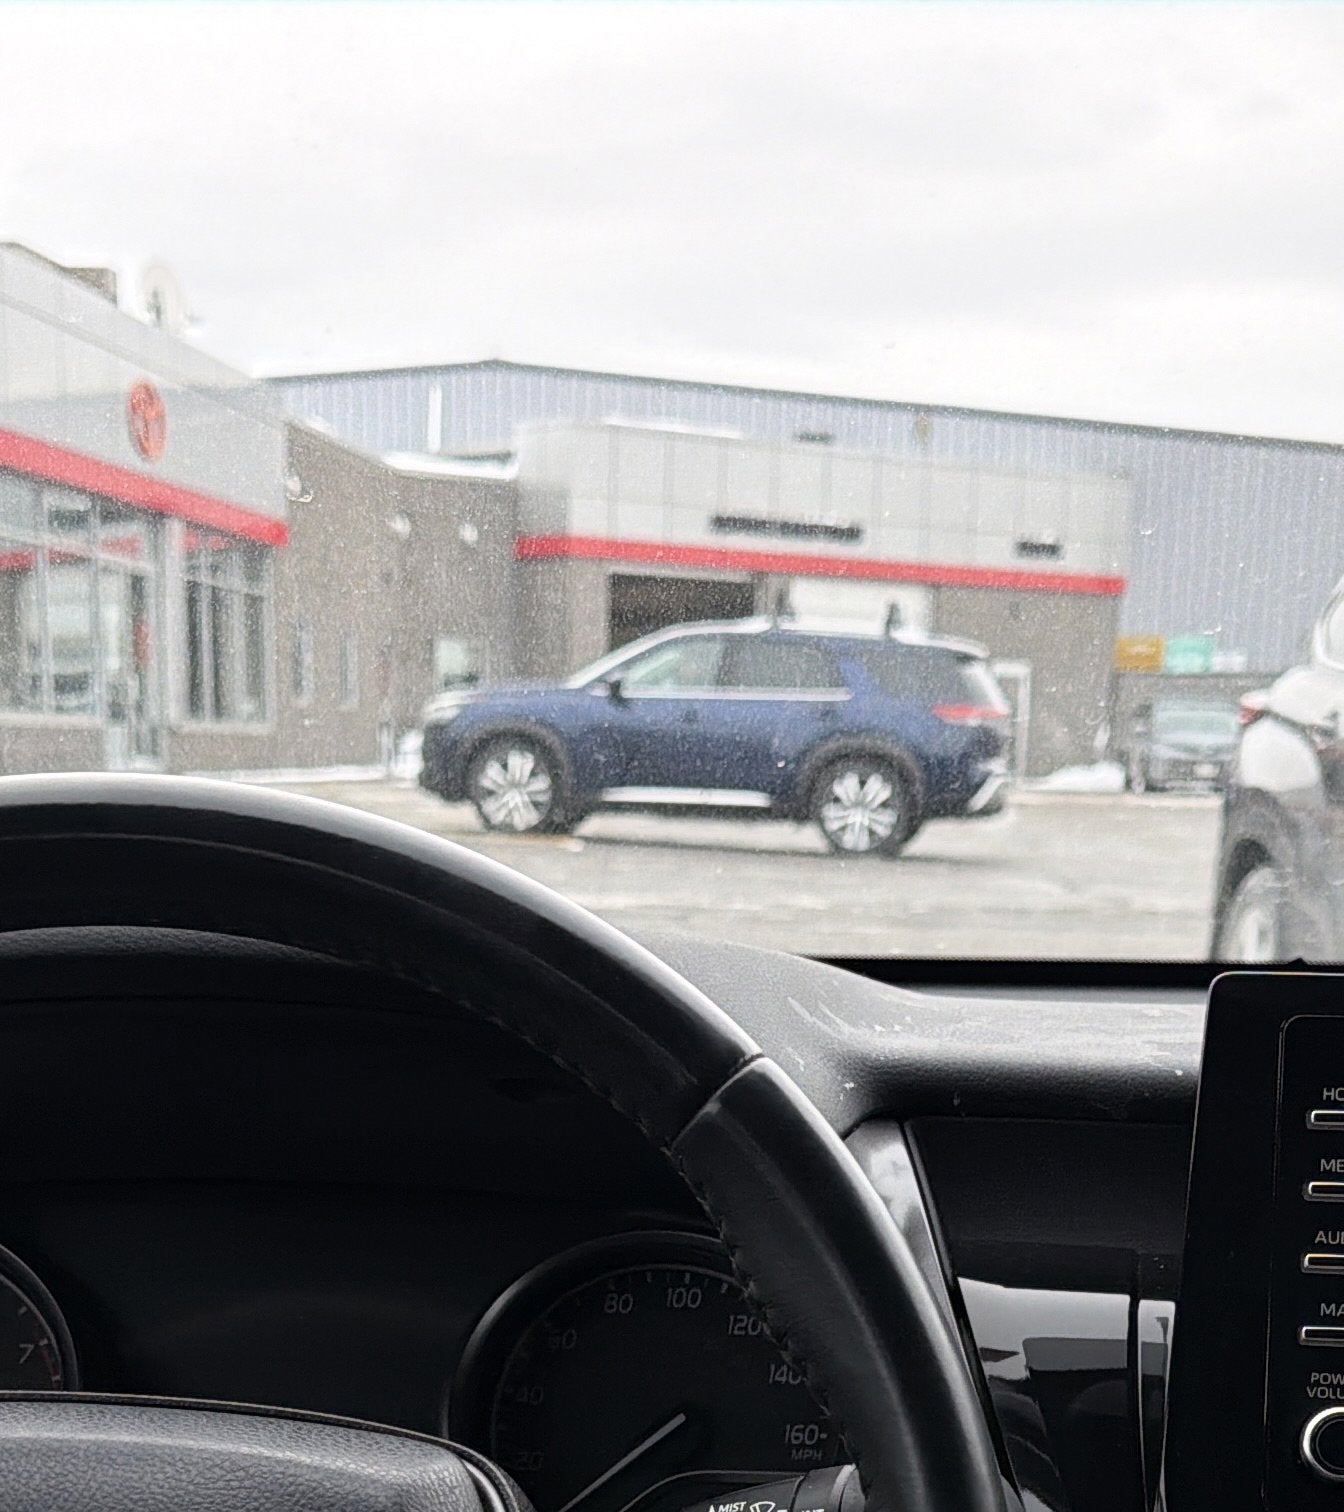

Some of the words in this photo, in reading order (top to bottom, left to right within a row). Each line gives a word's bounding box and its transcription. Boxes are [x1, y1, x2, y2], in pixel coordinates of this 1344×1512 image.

[603, 1293, 633, 1315] 80
[666, 1287, 702, 1309] 100
[727, 1315, 762, 1336] 120
[18, 1343, 34, 1365] 7
[784, 1423, 820, 1446] 160
[790, 1448, 823, 1462] MPH
